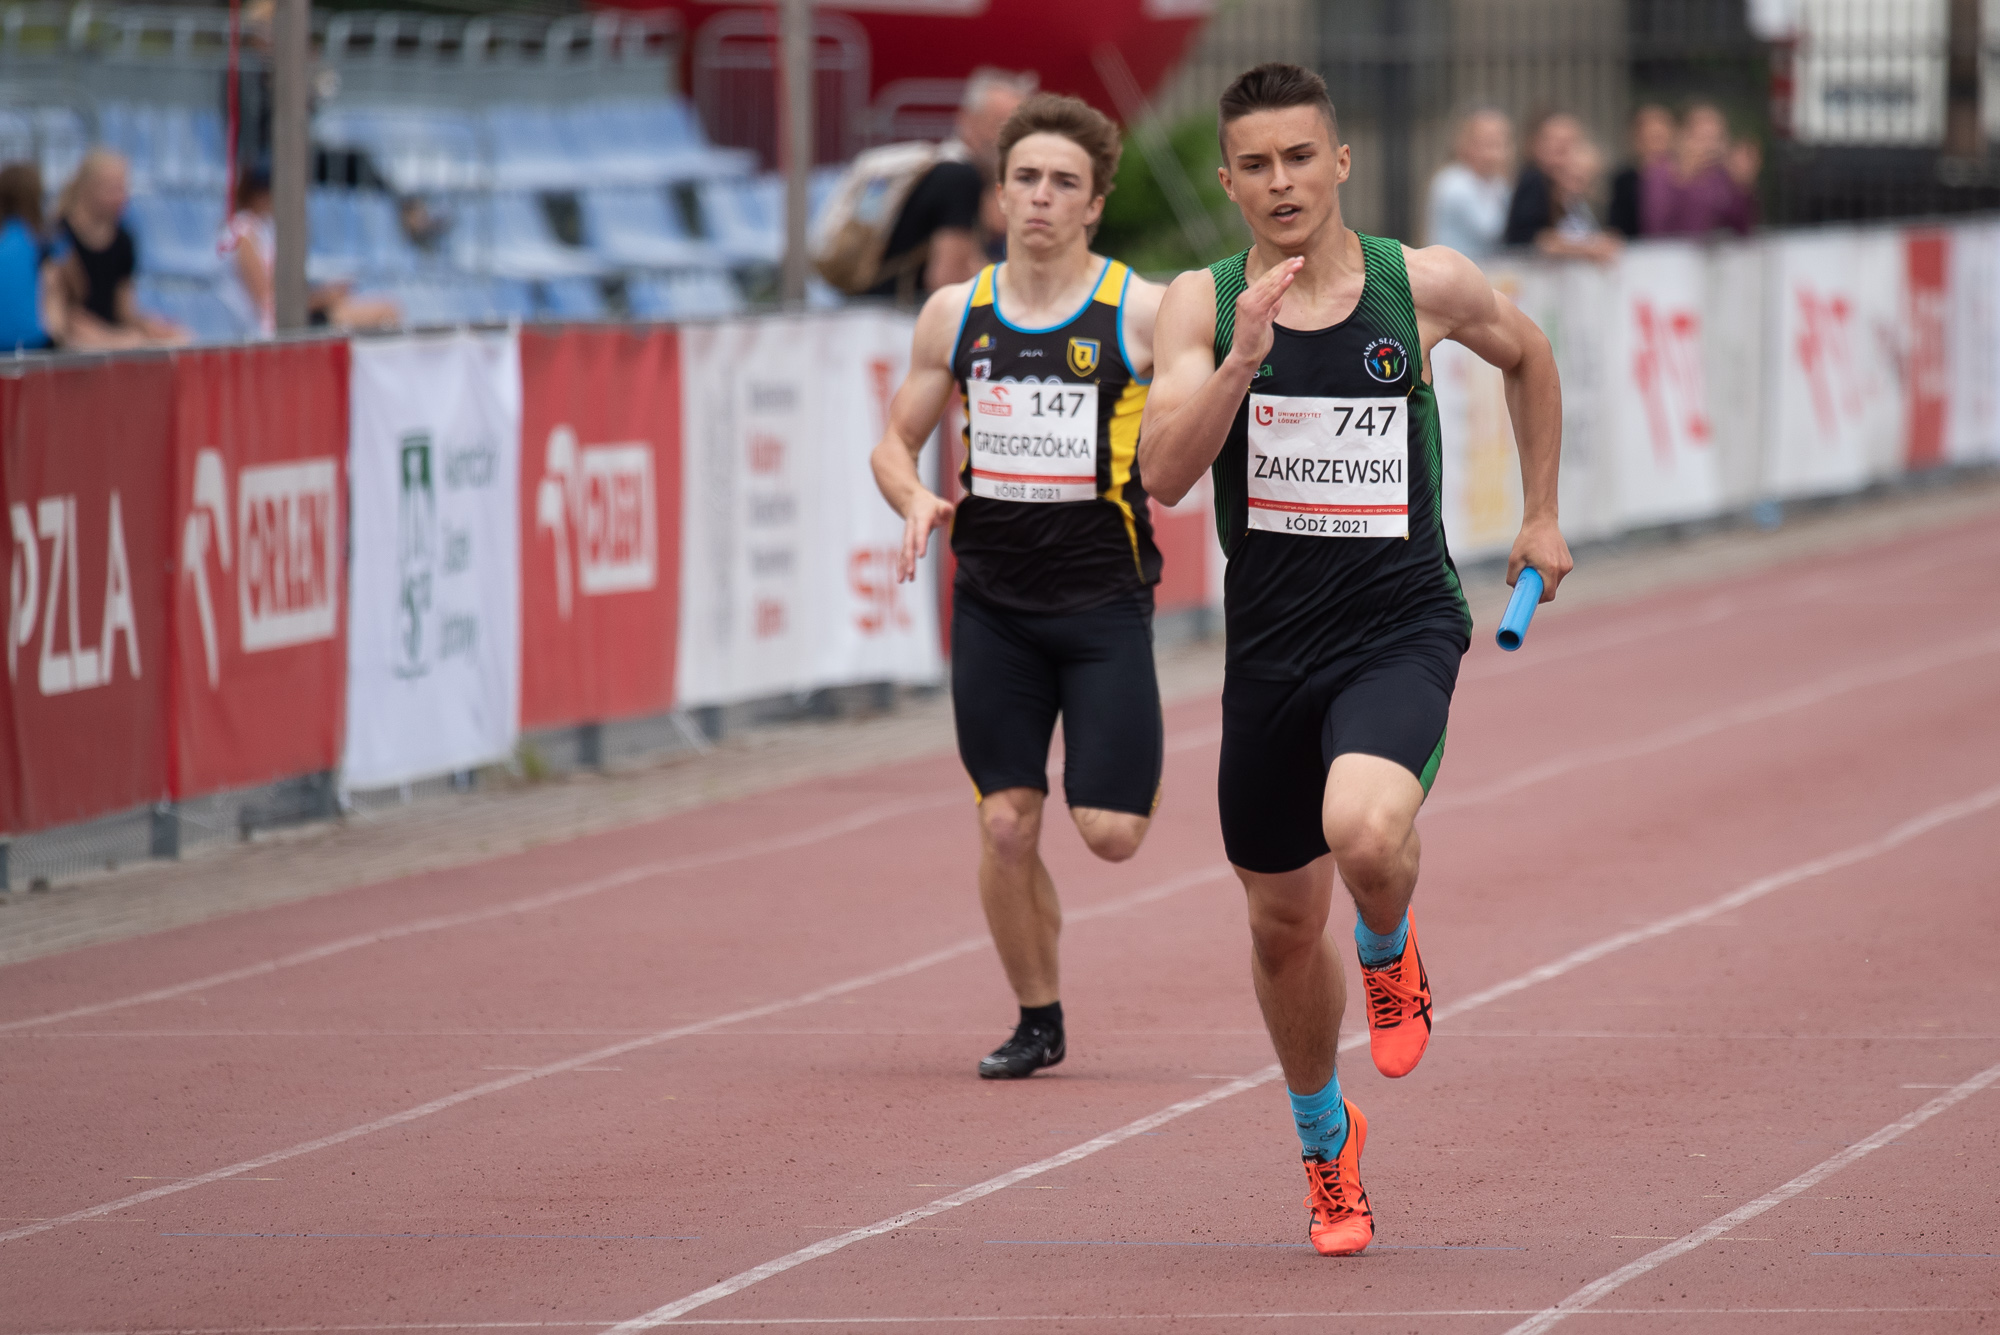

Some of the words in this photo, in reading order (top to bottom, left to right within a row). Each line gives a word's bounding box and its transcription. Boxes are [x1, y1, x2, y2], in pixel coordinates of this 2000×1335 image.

[1363, 341, 1378, 358] AML
[1030, 391, 1085, 418] 147
[1278, 411, 1321, 419] UNIWERSYTET
[1333, 406, 1397, 437] 747
[974, 431, 1091, 459] GRZEGRZÓŁKA
[1254, 454, 1402, 484] ZAKRZEWSKI
[994, 482, 1027, 499] ŁÓDŹ
[1030, 487, 1061, 500] 2021
[1285, 514, 1328, 534] ŁÓDŹ
[1332, 519, 1368, 534] 2021
[7, 487, 142, 697] PZLA
